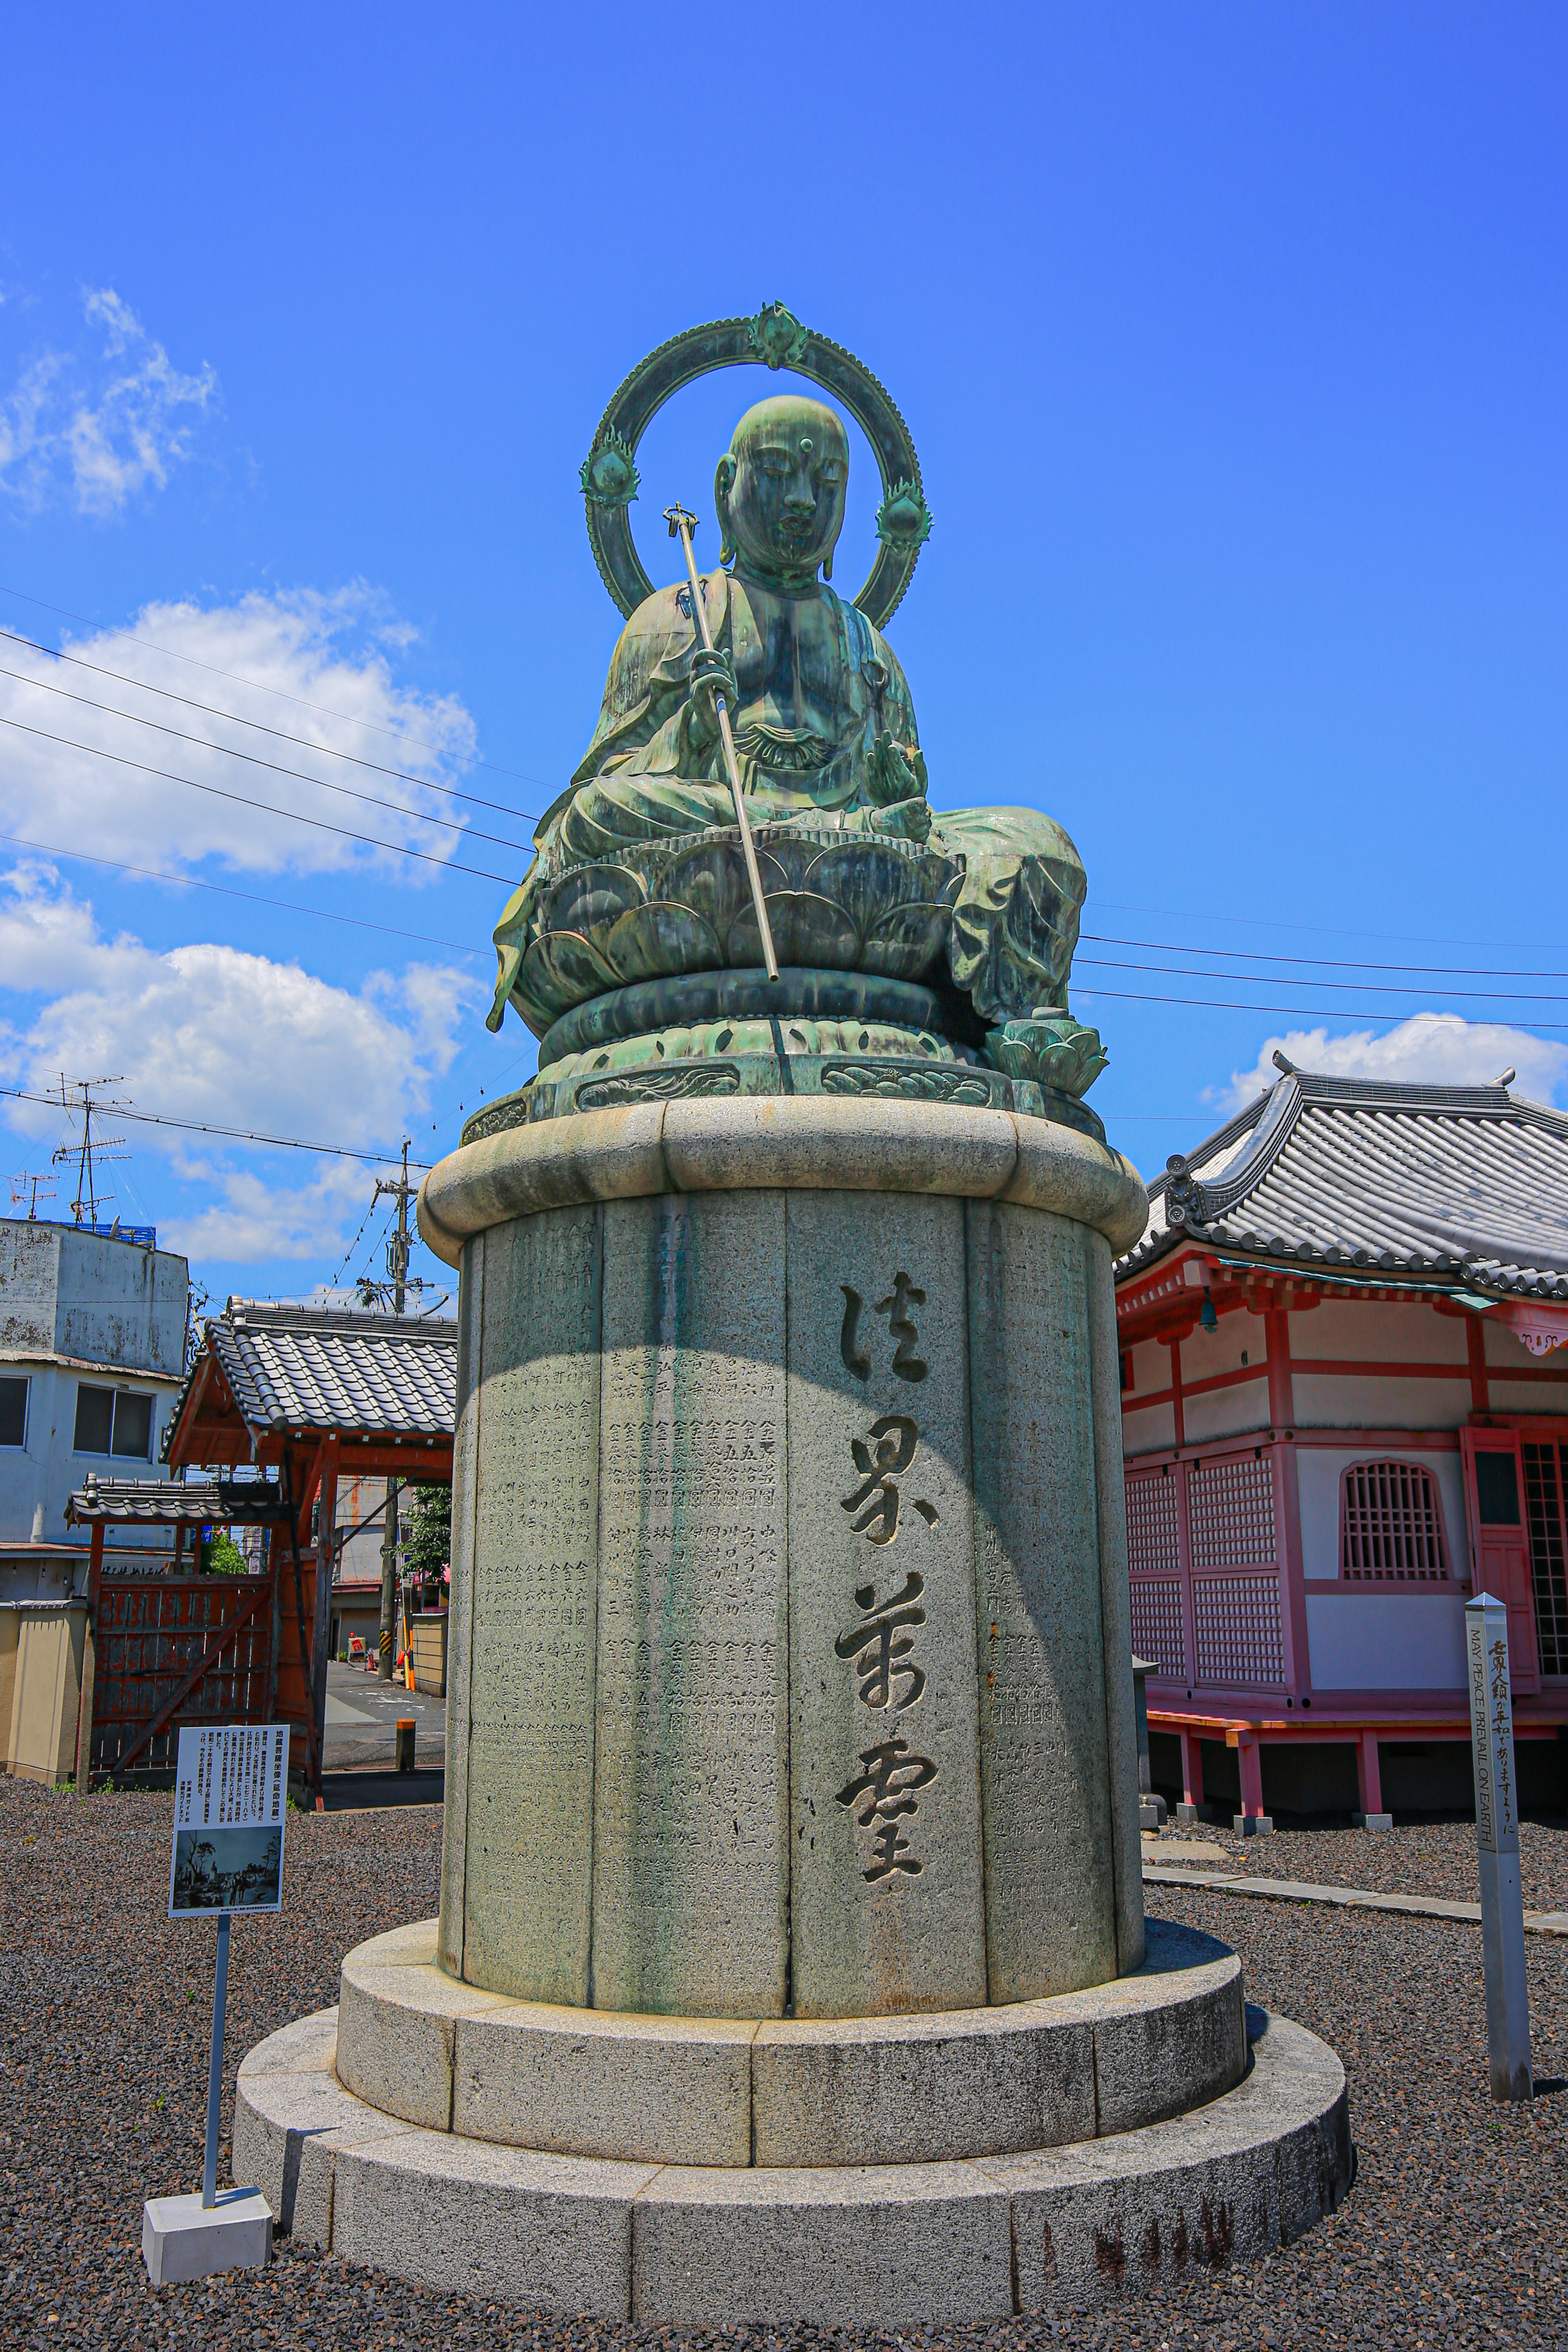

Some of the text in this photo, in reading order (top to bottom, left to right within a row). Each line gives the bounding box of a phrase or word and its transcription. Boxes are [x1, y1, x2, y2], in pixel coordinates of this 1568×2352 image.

[1471, 1629, 1492, 1843] MAY PEACE PREVAIL ON EARTH
[1488, 1640, 1515, 1835] 世界人類が平和でありますように
